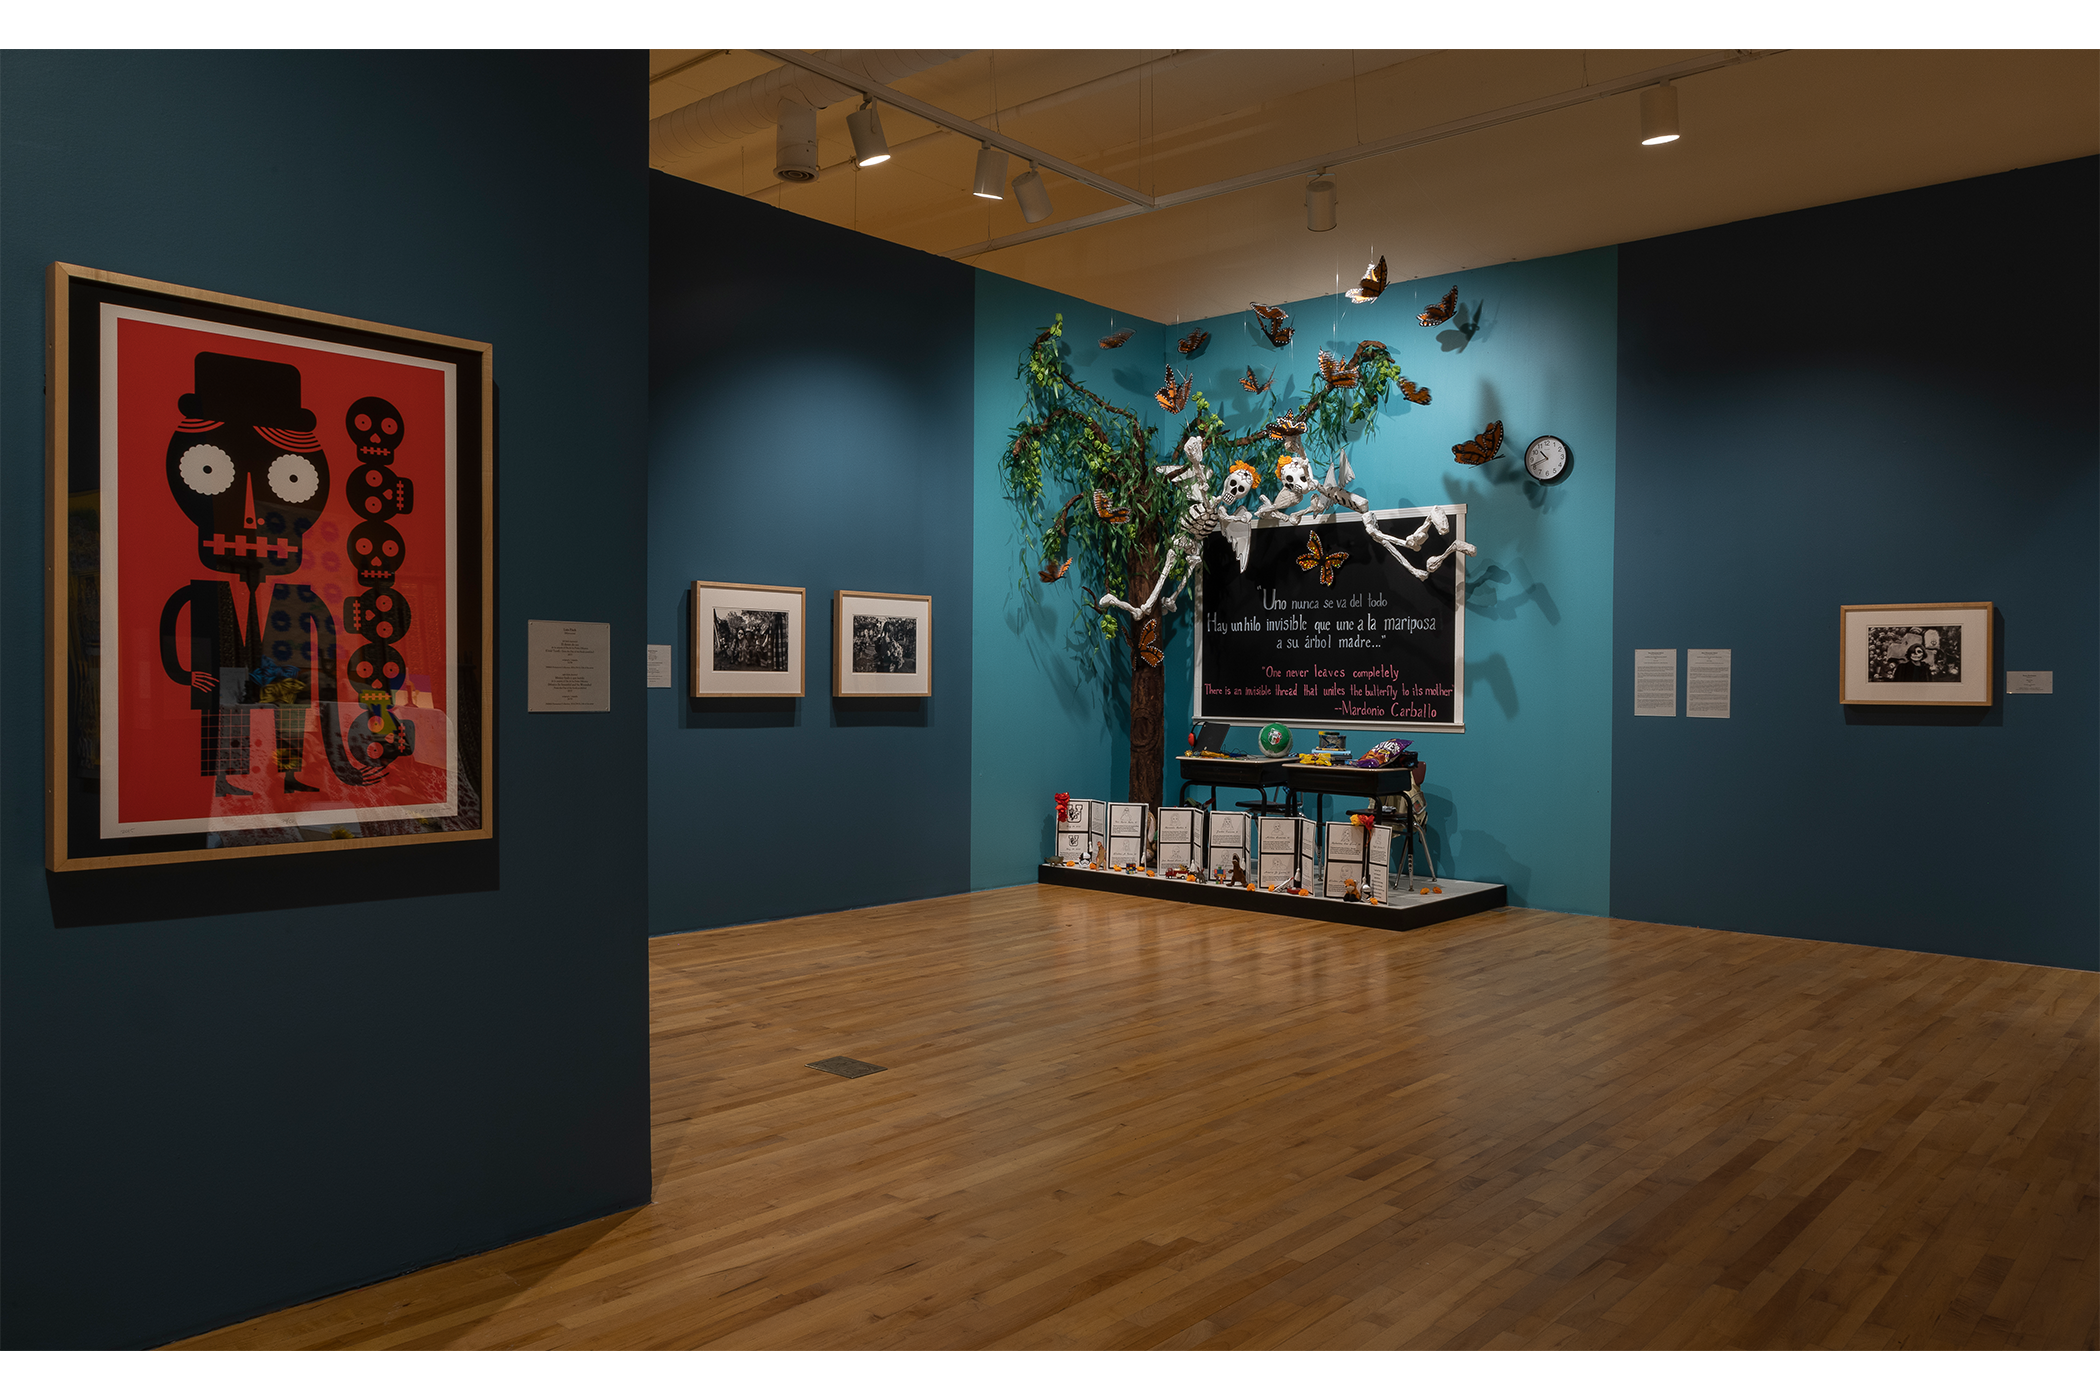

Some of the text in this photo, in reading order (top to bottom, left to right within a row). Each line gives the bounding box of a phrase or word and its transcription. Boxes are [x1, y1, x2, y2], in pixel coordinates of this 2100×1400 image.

[1291, 600, 1320, 610] nunca
[1322, 599, 1334, 609] se
[1335, 598, 1347, 609] va
[1349, 593, 1363, 608] del
[1367, 591, 1388, 608] todo
[1207, 611, 1228, 635] Hay
[1266, 613, 1308, 632] invisible
[1313, 619, 1332, 635] que
[1335, 620, 1355, 632] une
[1356, 618, 1365, 632] a
[1367, 612, 1377, 632] la
[1383, 615, 1437, 635] mariposa
[1276, 638, 1283, 650] a
[1286, 638, 1300, 649] su
[1303, 634, 1332, 649] árbol
[1285, 669, 1310, 678] never
[1313, 663, 1346, 678] leaves
[1352, 663, 1400, 682] completely
[1203, 682, 1223, 696] There
[1224, 686, 1232, 696] is
[1233, 687, 1243, 696] an
[1244, 684, 1272, 696] invisible
[1274, 682, 1298, 697] thread
[1303, 683, 1318, 697] that
[1322, 681, 1346, 697] unites
[1349, 683, 1363, 697] the
[1364, 683, 1398, 701] butterfly
[1401, 682, 1410, 697] to
[1411, 683, 1424, 697] its
[1389, 700, 1438, 719] Carballo
